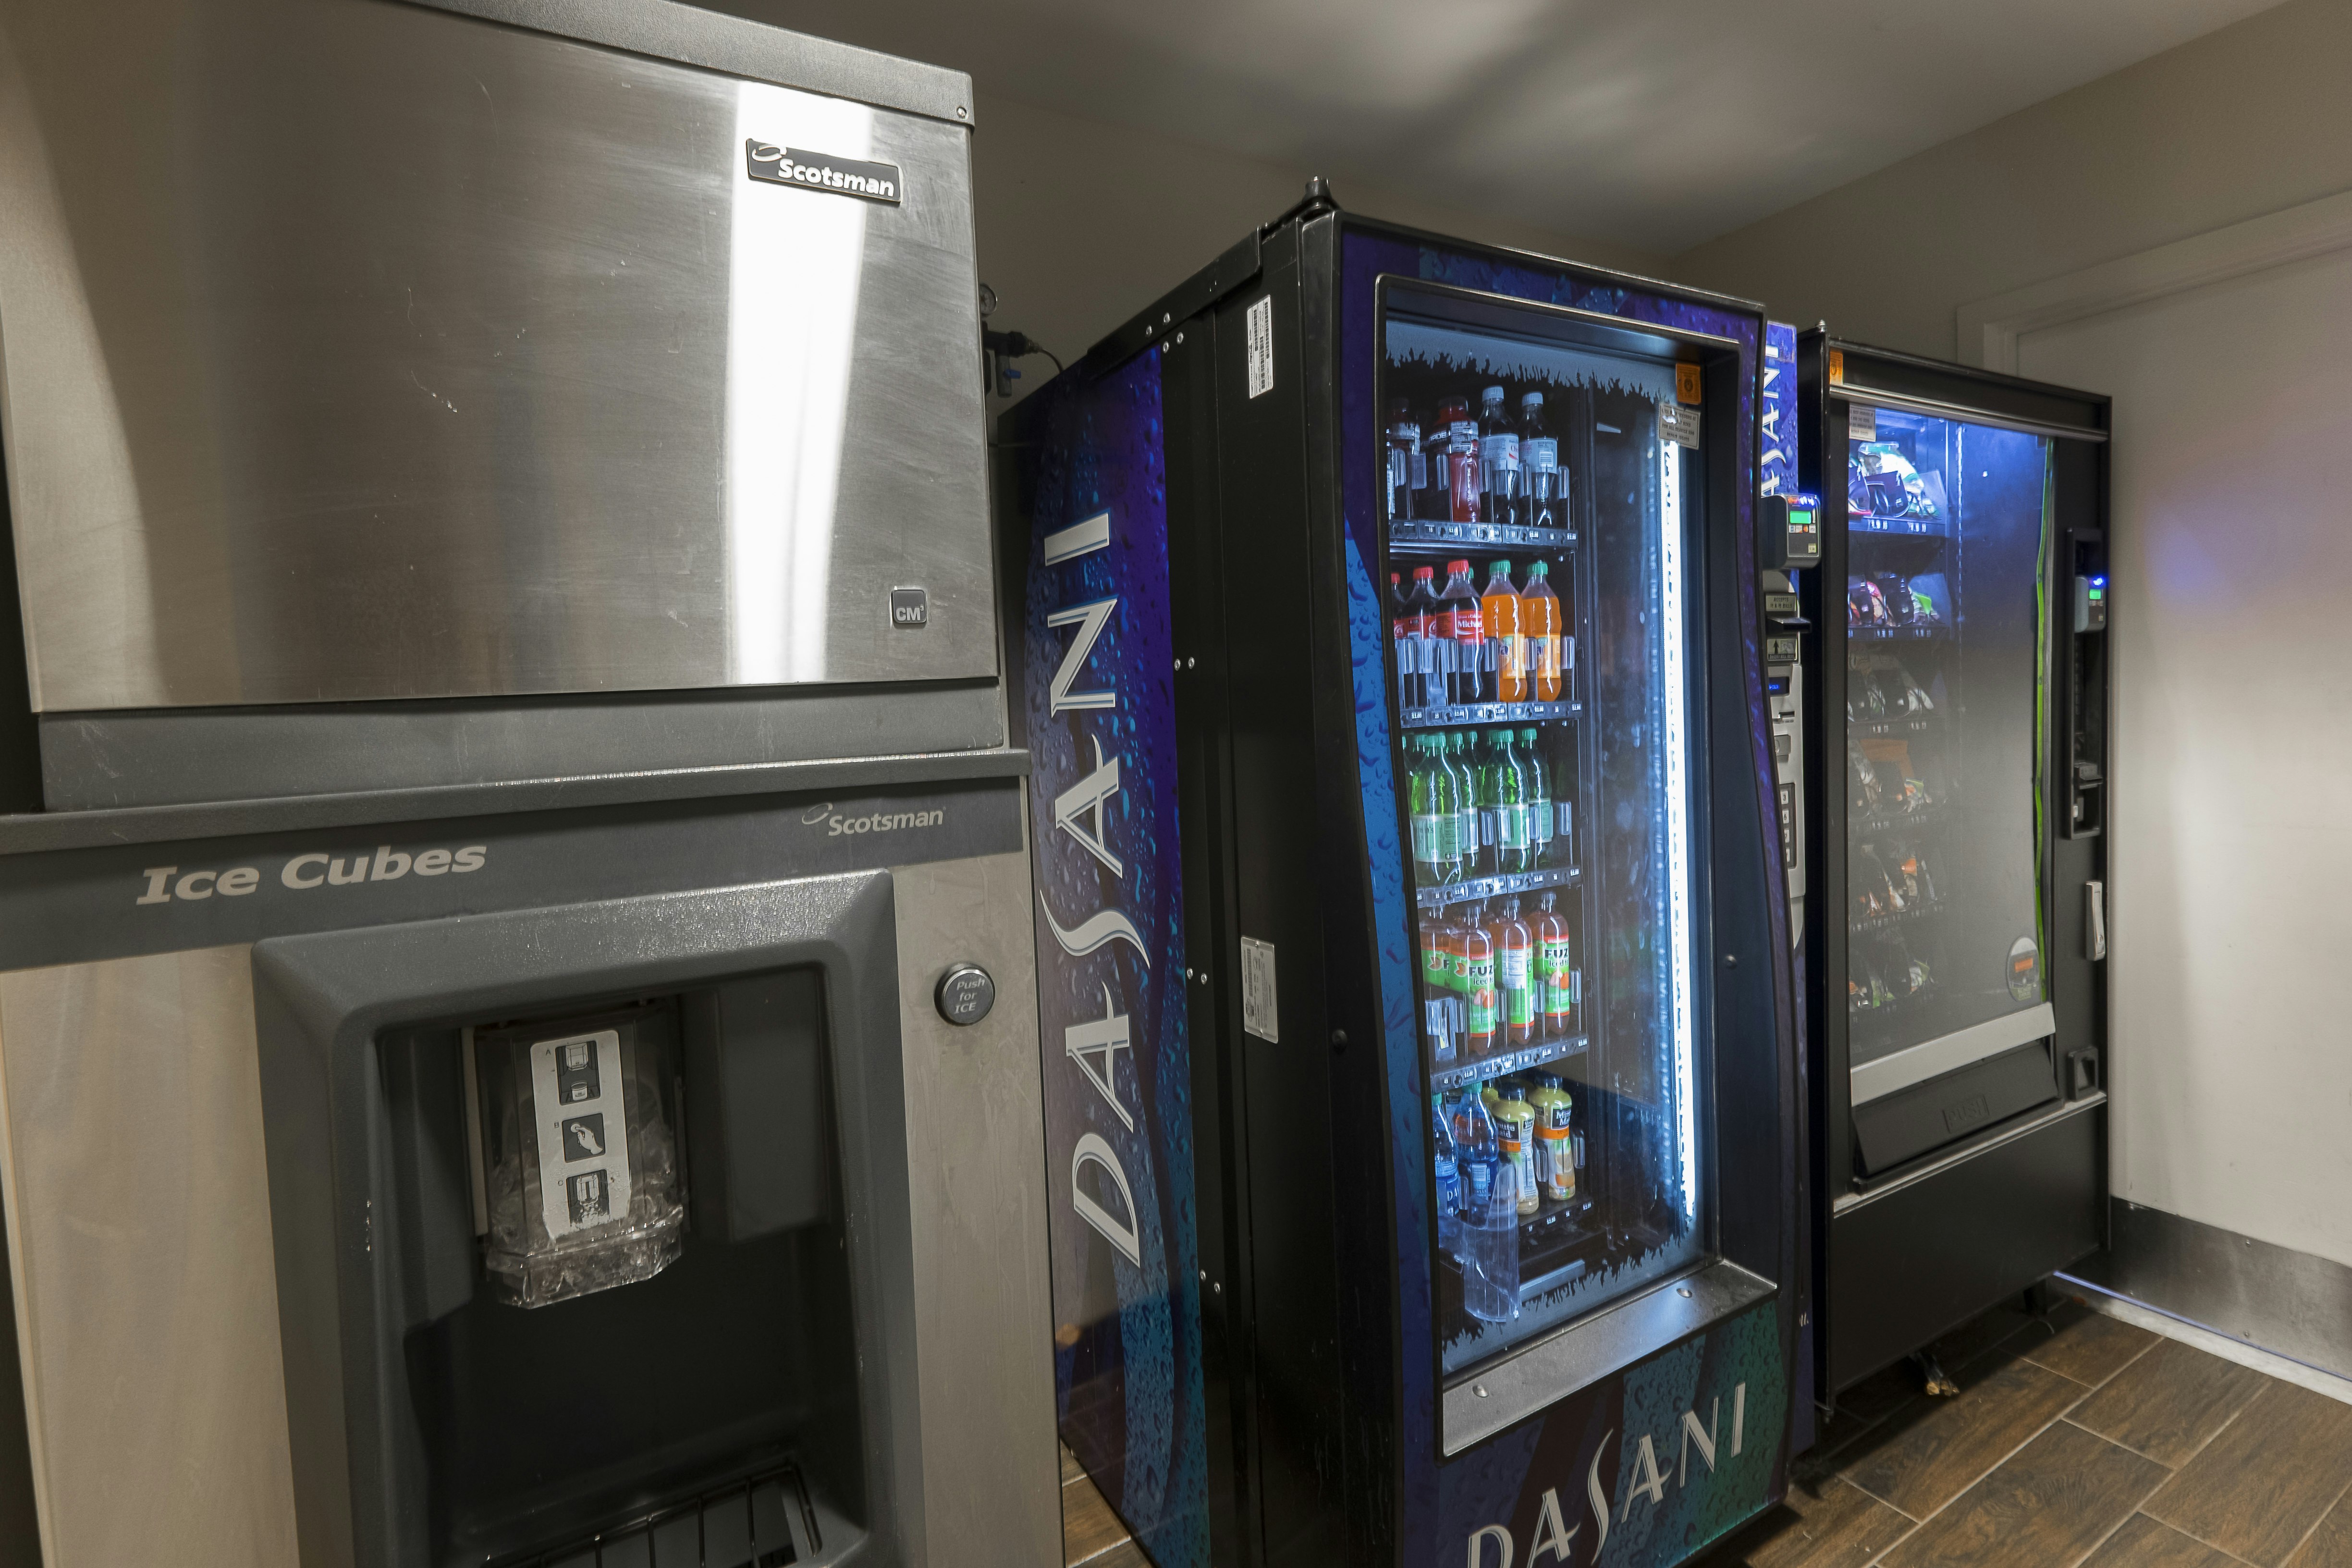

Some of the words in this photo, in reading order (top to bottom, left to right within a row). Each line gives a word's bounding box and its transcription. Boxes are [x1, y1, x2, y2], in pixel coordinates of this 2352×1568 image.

[778, 158, 894, 196] Scotsman
[1761, 346, 1786, 496] ASANI
[828, 810, 943, 836] Scotsman
[136, 864, 259, 906] Ice
[281, 845, 489, 890] Cubes
[1040, 511, 1150, 1269] DASANI
[956, 978, 986, 991] Push
[959, 992, 977, 1002] for
[954, 1002, 977, 1014] ICE
